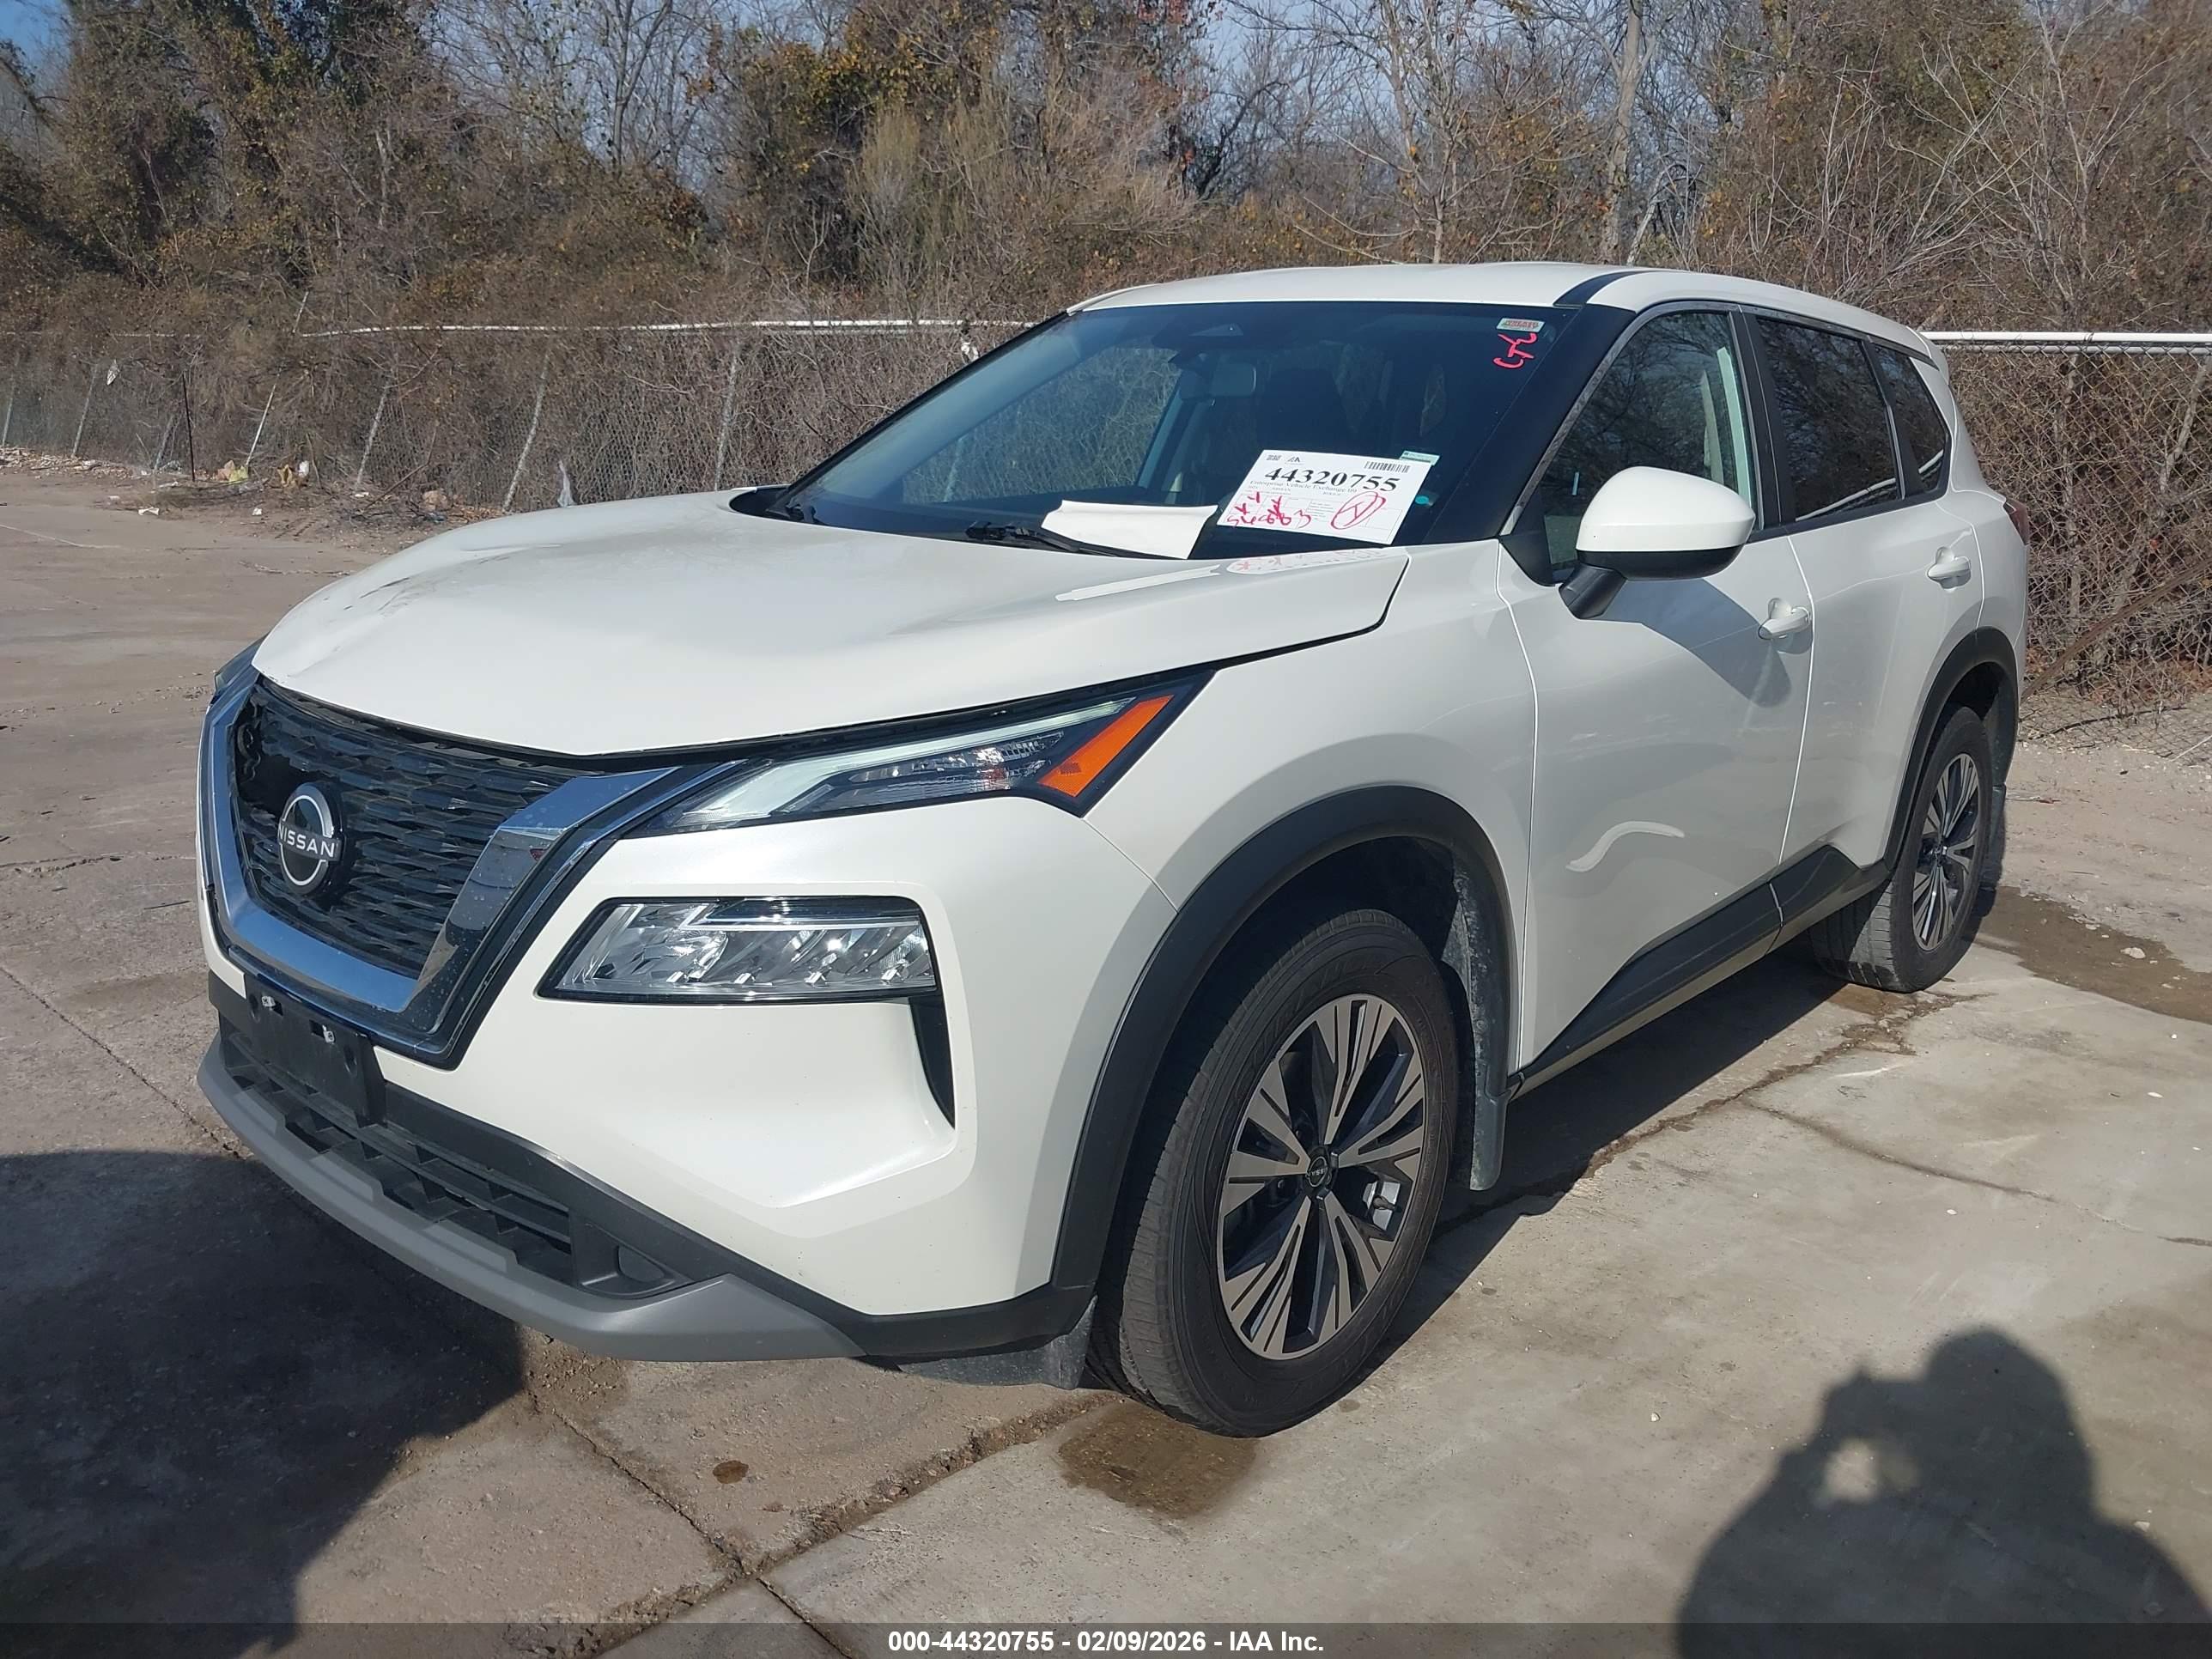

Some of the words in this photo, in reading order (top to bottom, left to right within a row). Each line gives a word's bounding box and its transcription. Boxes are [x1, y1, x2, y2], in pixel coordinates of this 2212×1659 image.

[1264, 467, 1400, 492] 44320755
[1313, 484, 1346, 493] Exchange
[277, 824, 335, 857] NISSAN
